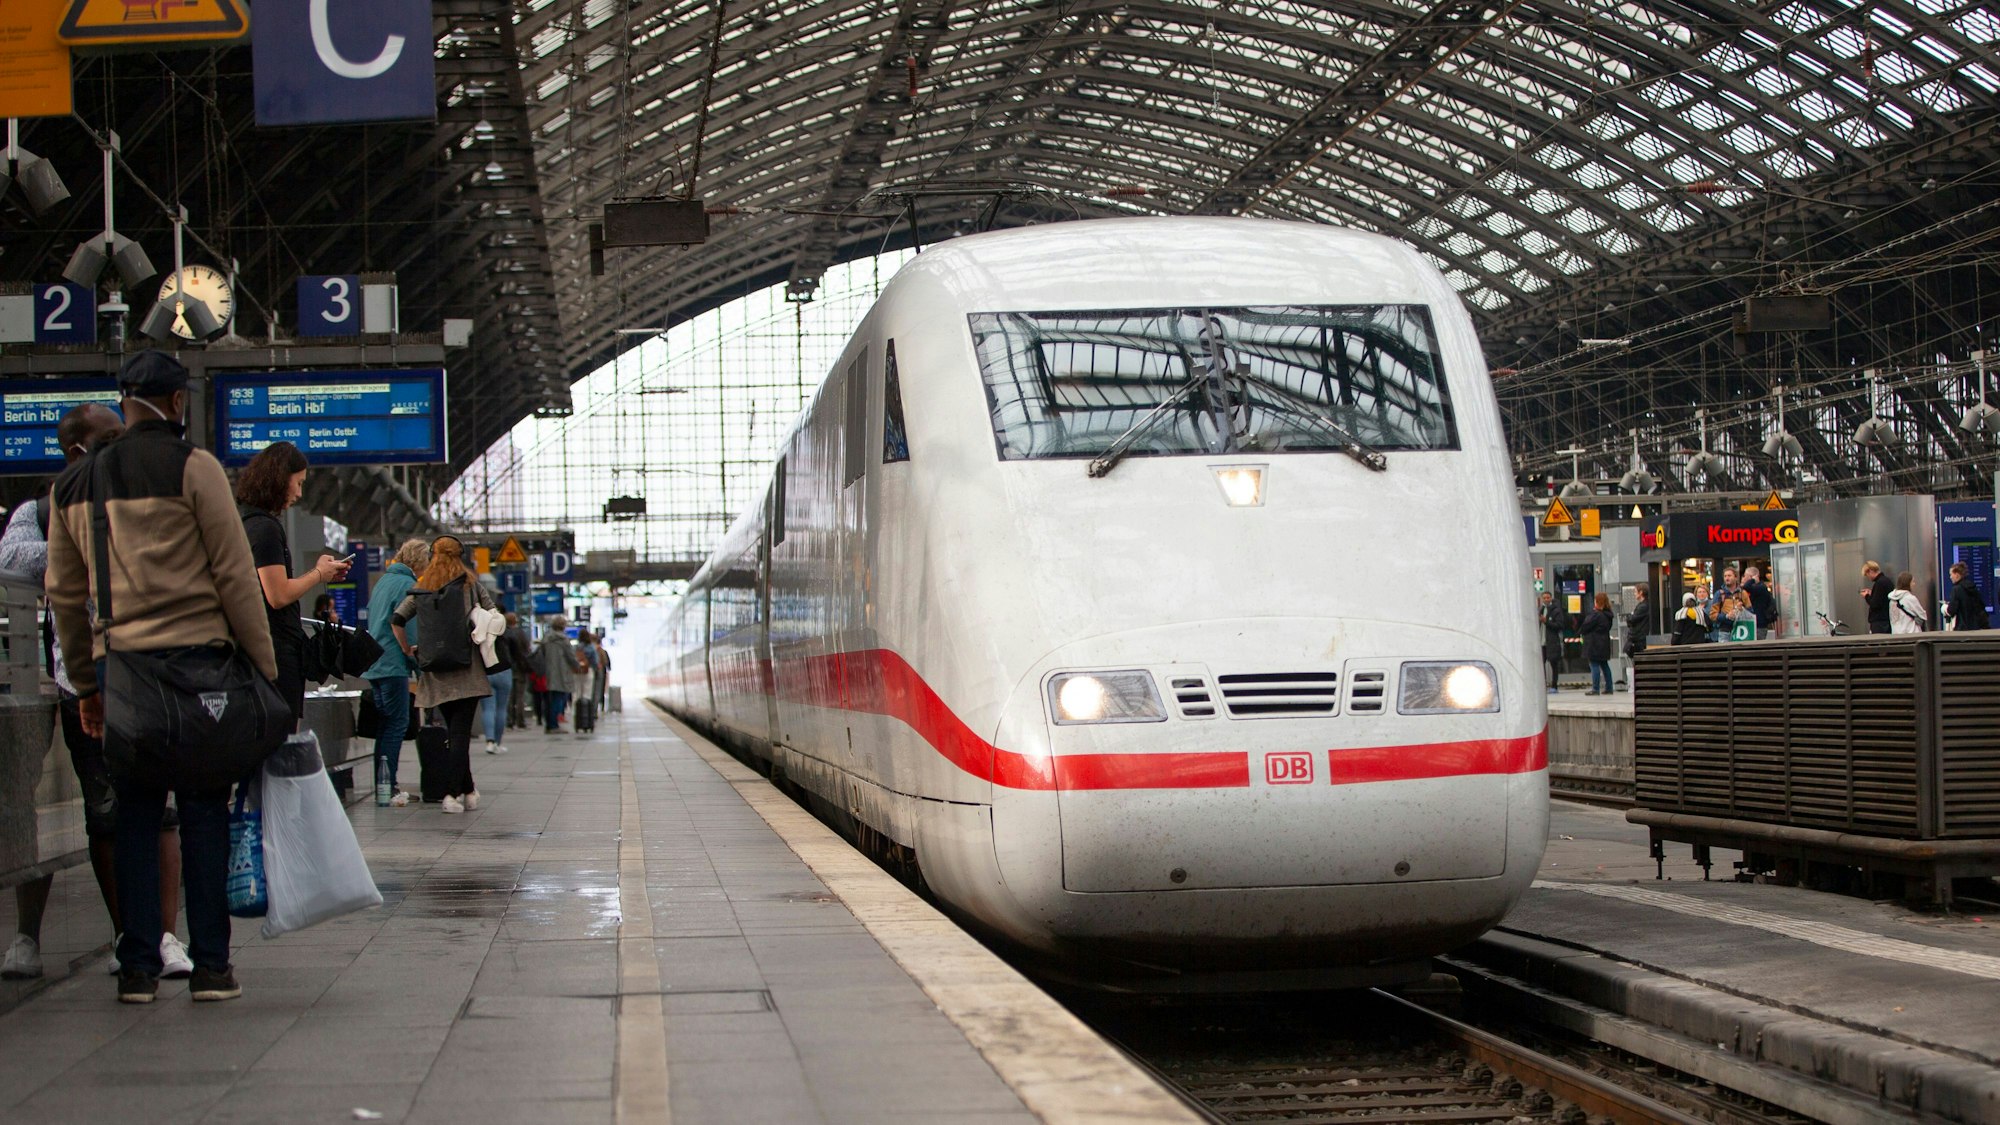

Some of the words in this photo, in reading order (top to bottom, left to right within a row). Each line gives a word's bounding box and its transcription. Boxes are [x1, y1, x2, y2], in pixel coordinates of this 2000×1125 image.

[309, 0, 406, 79] C
[43, 285, 72, 331] 2
[320, 277, 352, 323] 3
[229, 388, 254, 398] 16:38
[4, 410, 37, 422] Berlin
[40, 409, 60, 421] Hbf
[268, 403, 302, 414] Berlin
[304, 401, 325, 413] Hbf
[14, 437, 31, 445] 2043
[230, 430, 252, 438] 16:38
[283, 429, 300, 437] 1153
[309, 428, 332, 437] Berlin
[333, 427, 359, 436] Ostbf.
[309, 439, 348, 448] Dortmund
[1707, 524, 1774, 546] Kamps
[552, 551, 570, 575] D
[1270, 756, 1309, 780] DB
